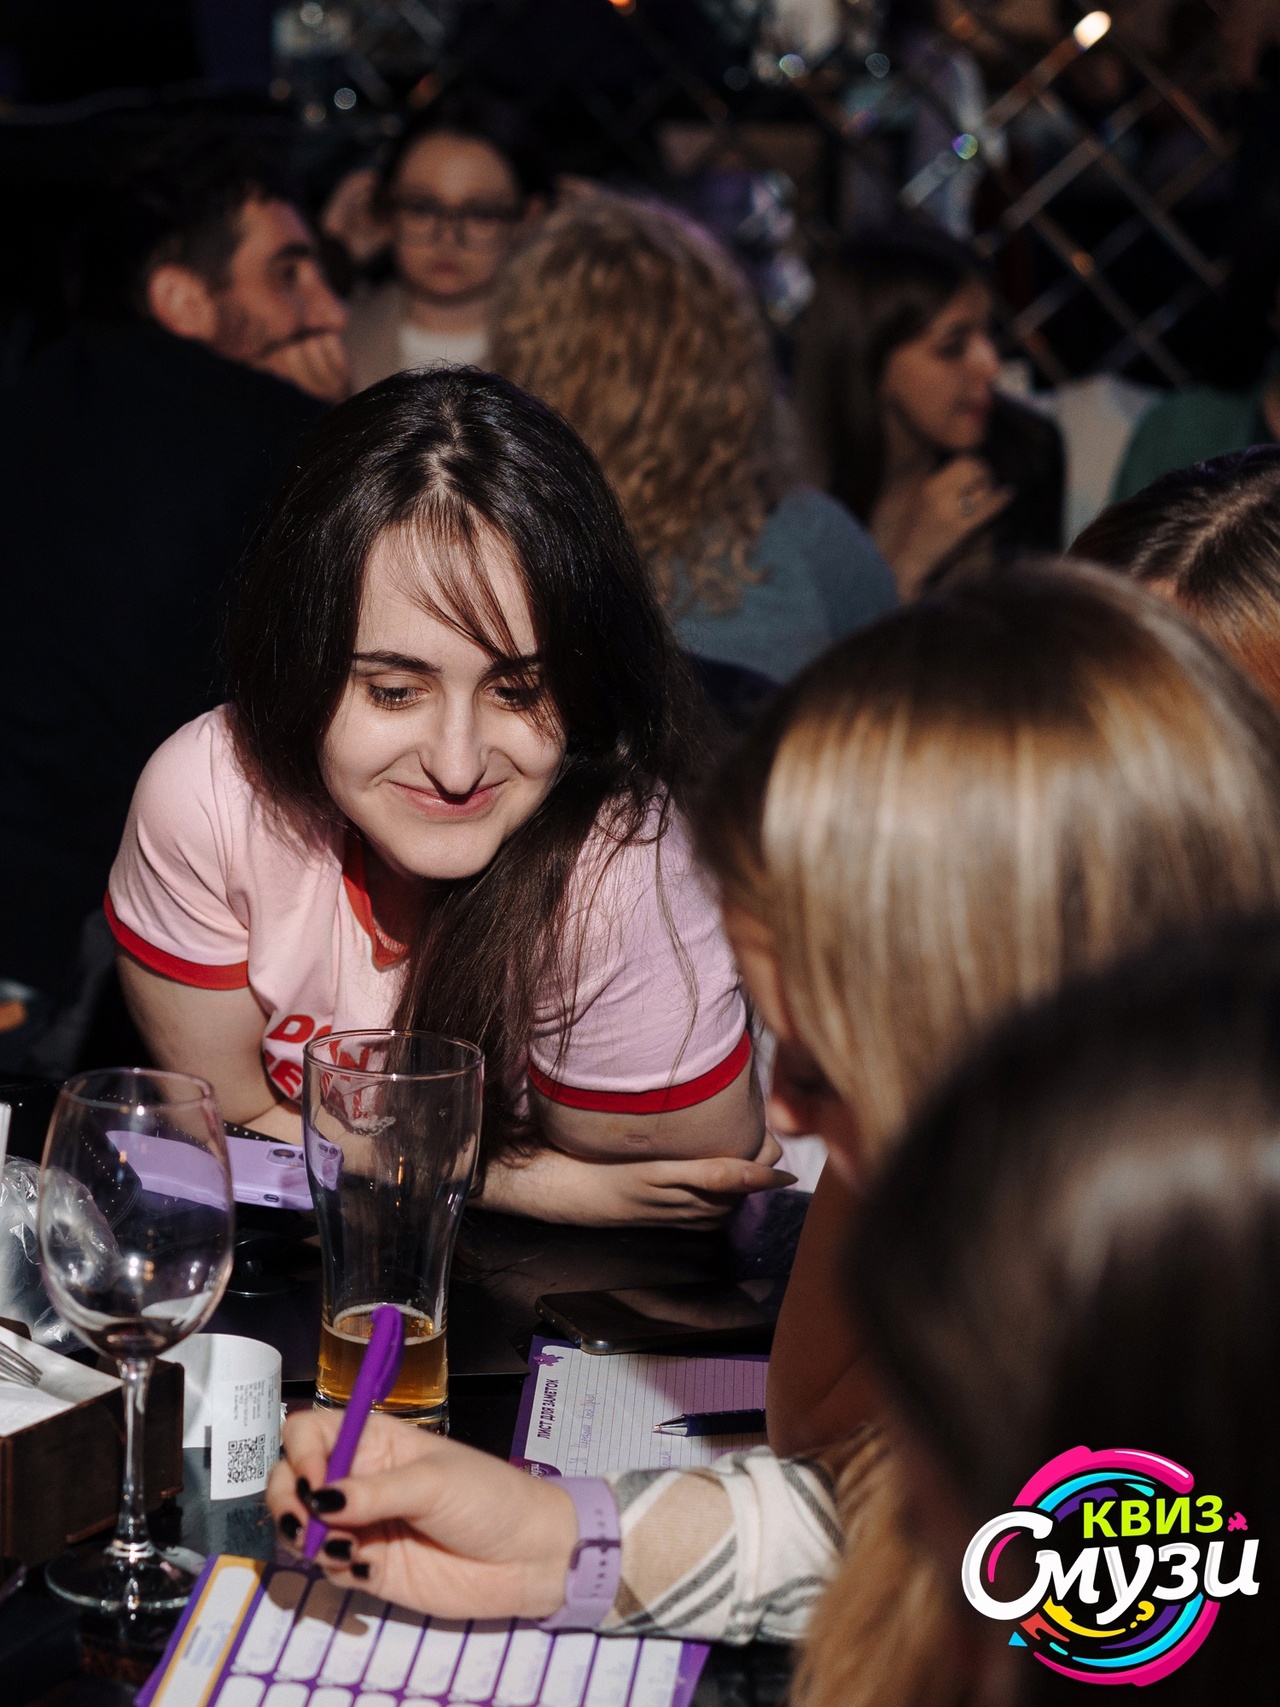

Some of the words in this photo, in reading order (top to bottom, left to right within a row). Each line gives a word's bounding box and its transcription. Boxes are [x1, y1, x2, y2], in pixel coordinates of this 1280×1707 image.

[542, 1378, 559, 1407] ЗАМЕТОК
[540, 1406, 556, 1422] ДЛЯ
[537, 1420, 552, 1439] ЛИСТ
